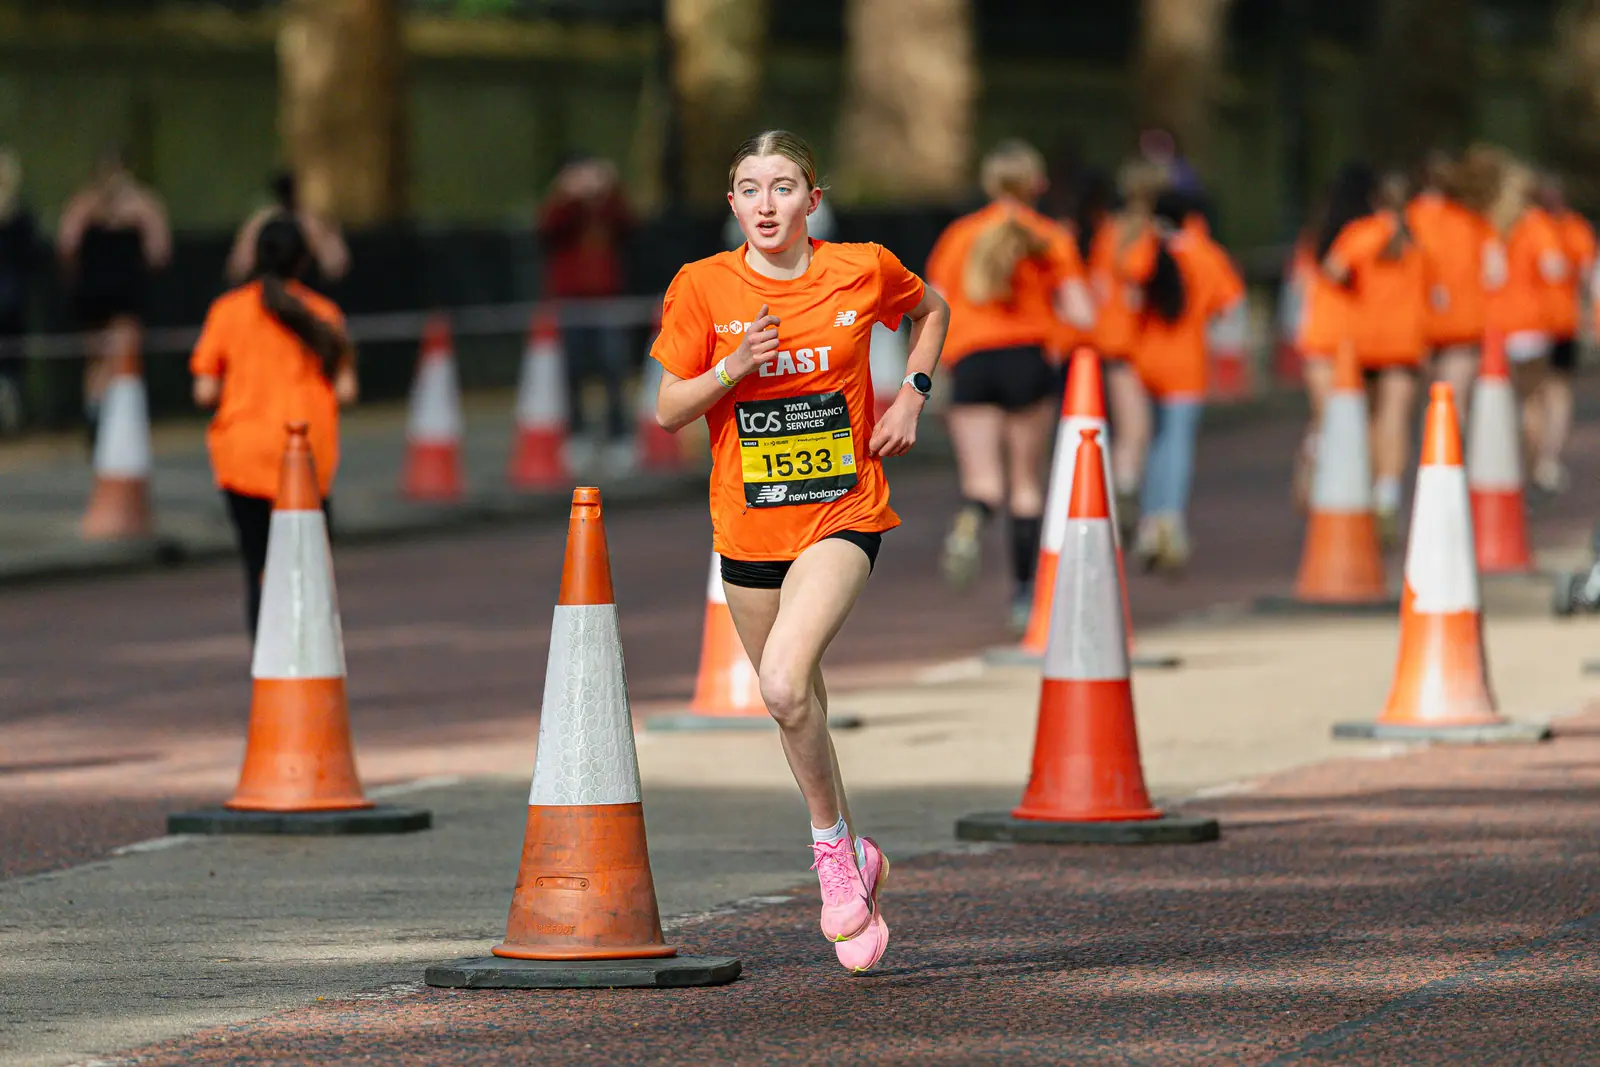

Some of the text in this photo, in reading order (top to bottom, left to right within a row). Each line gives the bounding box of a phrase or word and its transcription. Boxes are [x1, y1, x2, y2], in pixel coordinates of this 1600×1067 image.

[759, 346, 832, 377] EAST
[784, 402, 810, 412] TATA
[785, 406, 844, 421] CONSULTANCY
[739, 408, 782, 433] tcs
[786, 419, 825, 431] SERVICES
[762, 448, 833, 477] 1533
[788, 487, 848, 502] new balance
